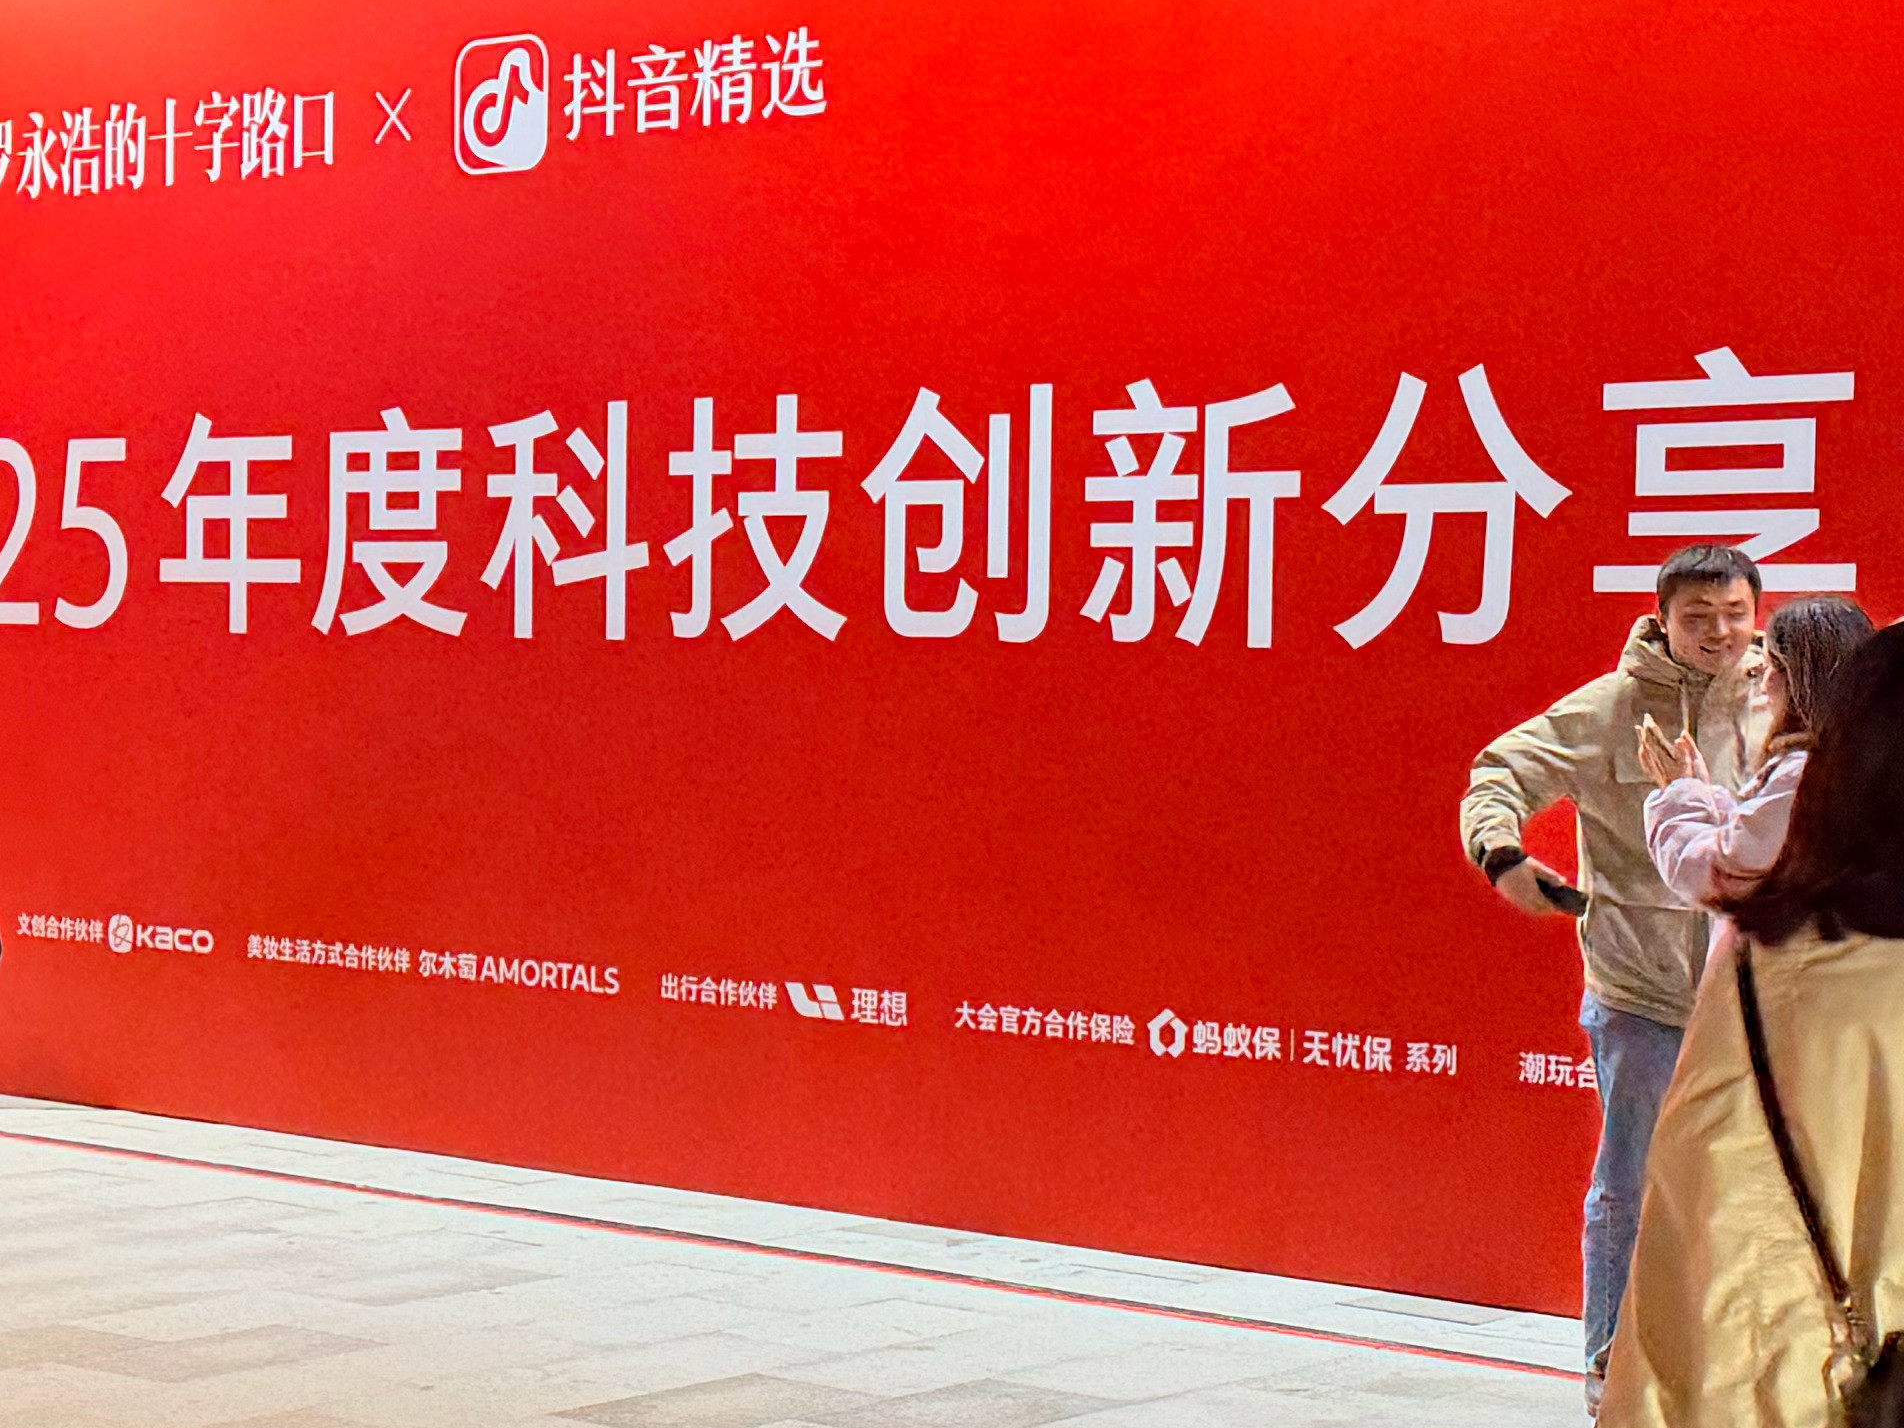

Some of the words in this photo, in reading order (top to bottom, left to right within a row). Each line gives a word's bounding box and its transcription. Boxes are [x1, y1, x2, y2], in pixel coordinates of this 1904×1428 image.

[563, 26, 827, 141] 抖音精选
[17, 912, 104, 943] 文创合作伙伴
[247, 934, 411, 973] 美妆生活方式合作伙伴
[480, 955, 620, 995] AMORTALS
[661, 972, 777, 1010] 出行合作伙伴
[850, 987, 908, 1027] 理想
[954, 1000, 1135, 1045] 大会官方合作保险
[1405, 1042, 1457, 1076] 系列
